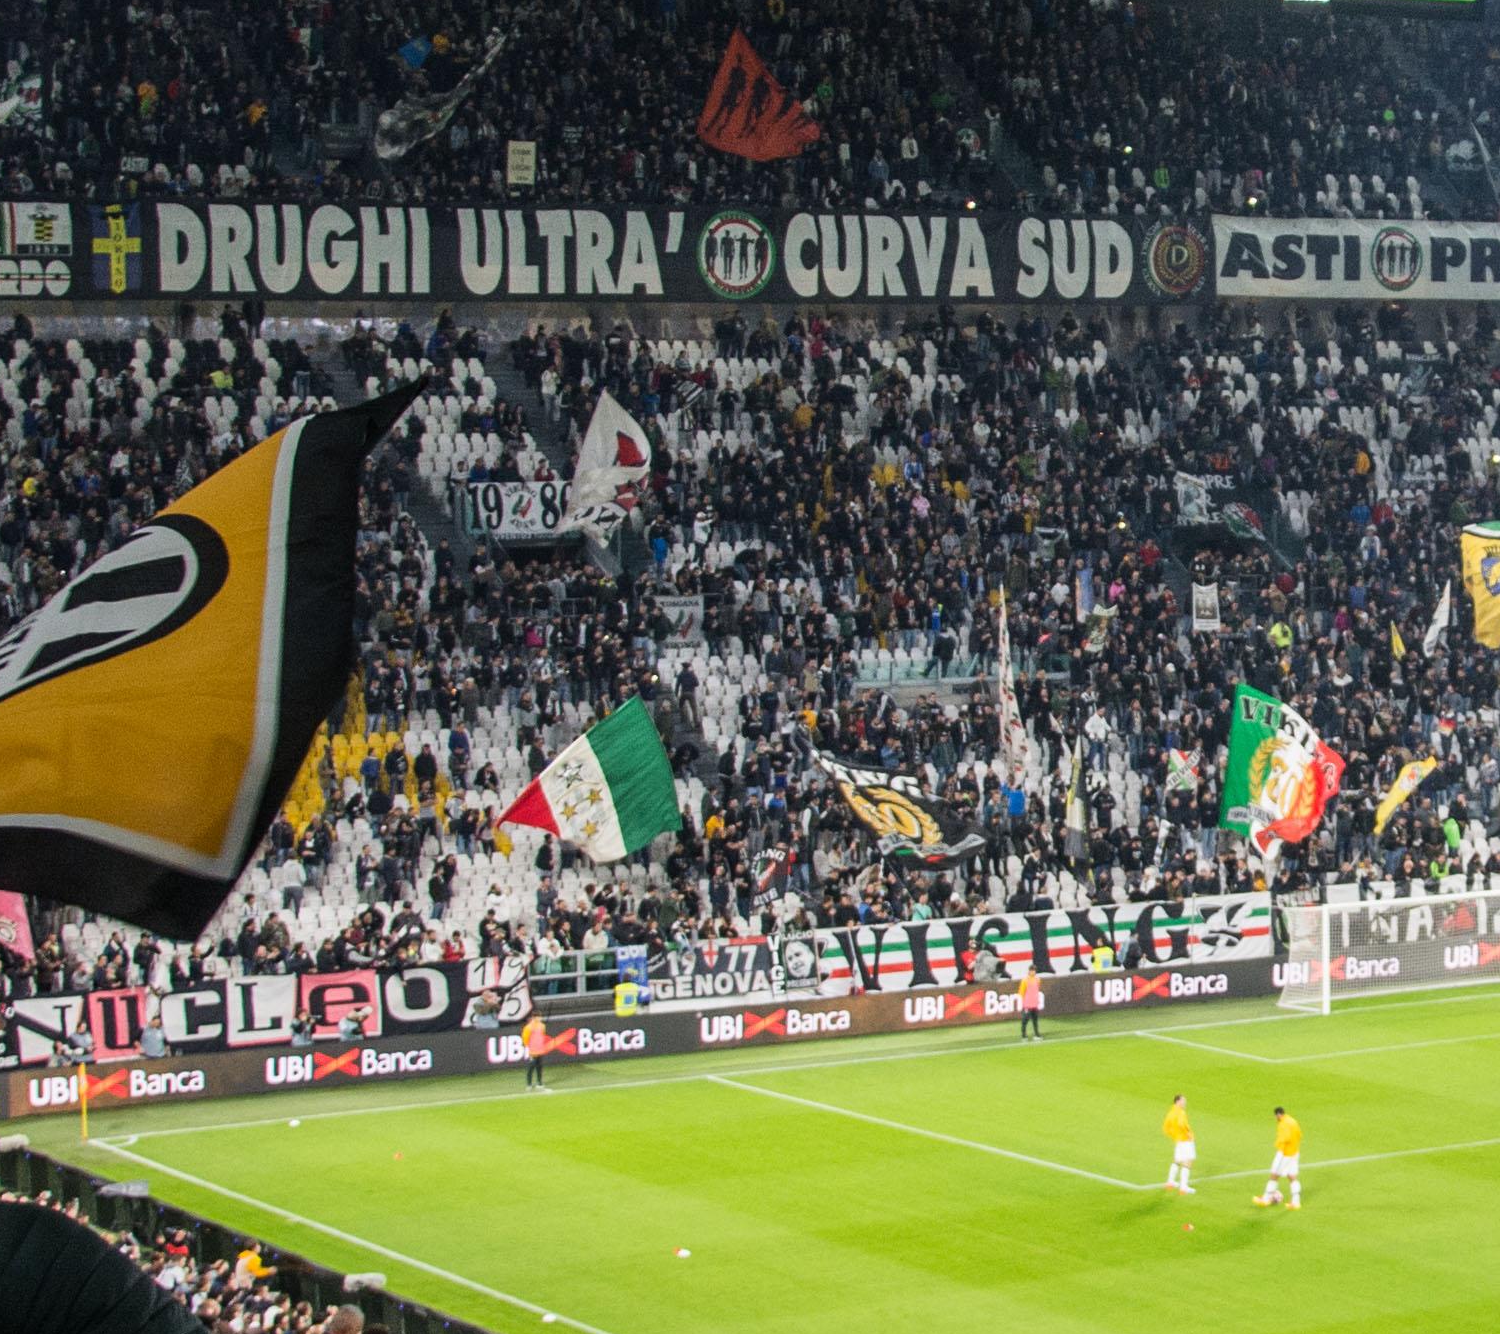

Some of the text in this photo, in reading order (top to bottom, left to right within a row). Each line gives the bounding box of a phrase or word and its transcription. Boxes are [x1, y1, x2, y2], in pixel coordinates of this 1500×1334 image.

[156, 202, 431, 297] DRUGHI
[459, 206, 685, 297] ULTRA'
[784, 212, 995, 298] CURVA
[1018, 218, 1134, 299] SUD
[1218, 229, 1362, 284] ASTI
[724, 945, 757, 971] 77
[1344, 955, 1400, 980] Banca
[1445, 944, 1479, 969] UBI
[657, 970, 770, 1000] GENOVA
[1094, 967, 1228, 1005] UBI Banca
[904, 993, 944, 1023] UBI
[577, 1027, 646, 1055] Banca
[701, 1008, 850, 1044] UBI Banca
[266, 1046, 433, 1085] UBI Banca
[29, 1068, 205, 1107] UBI Banca
